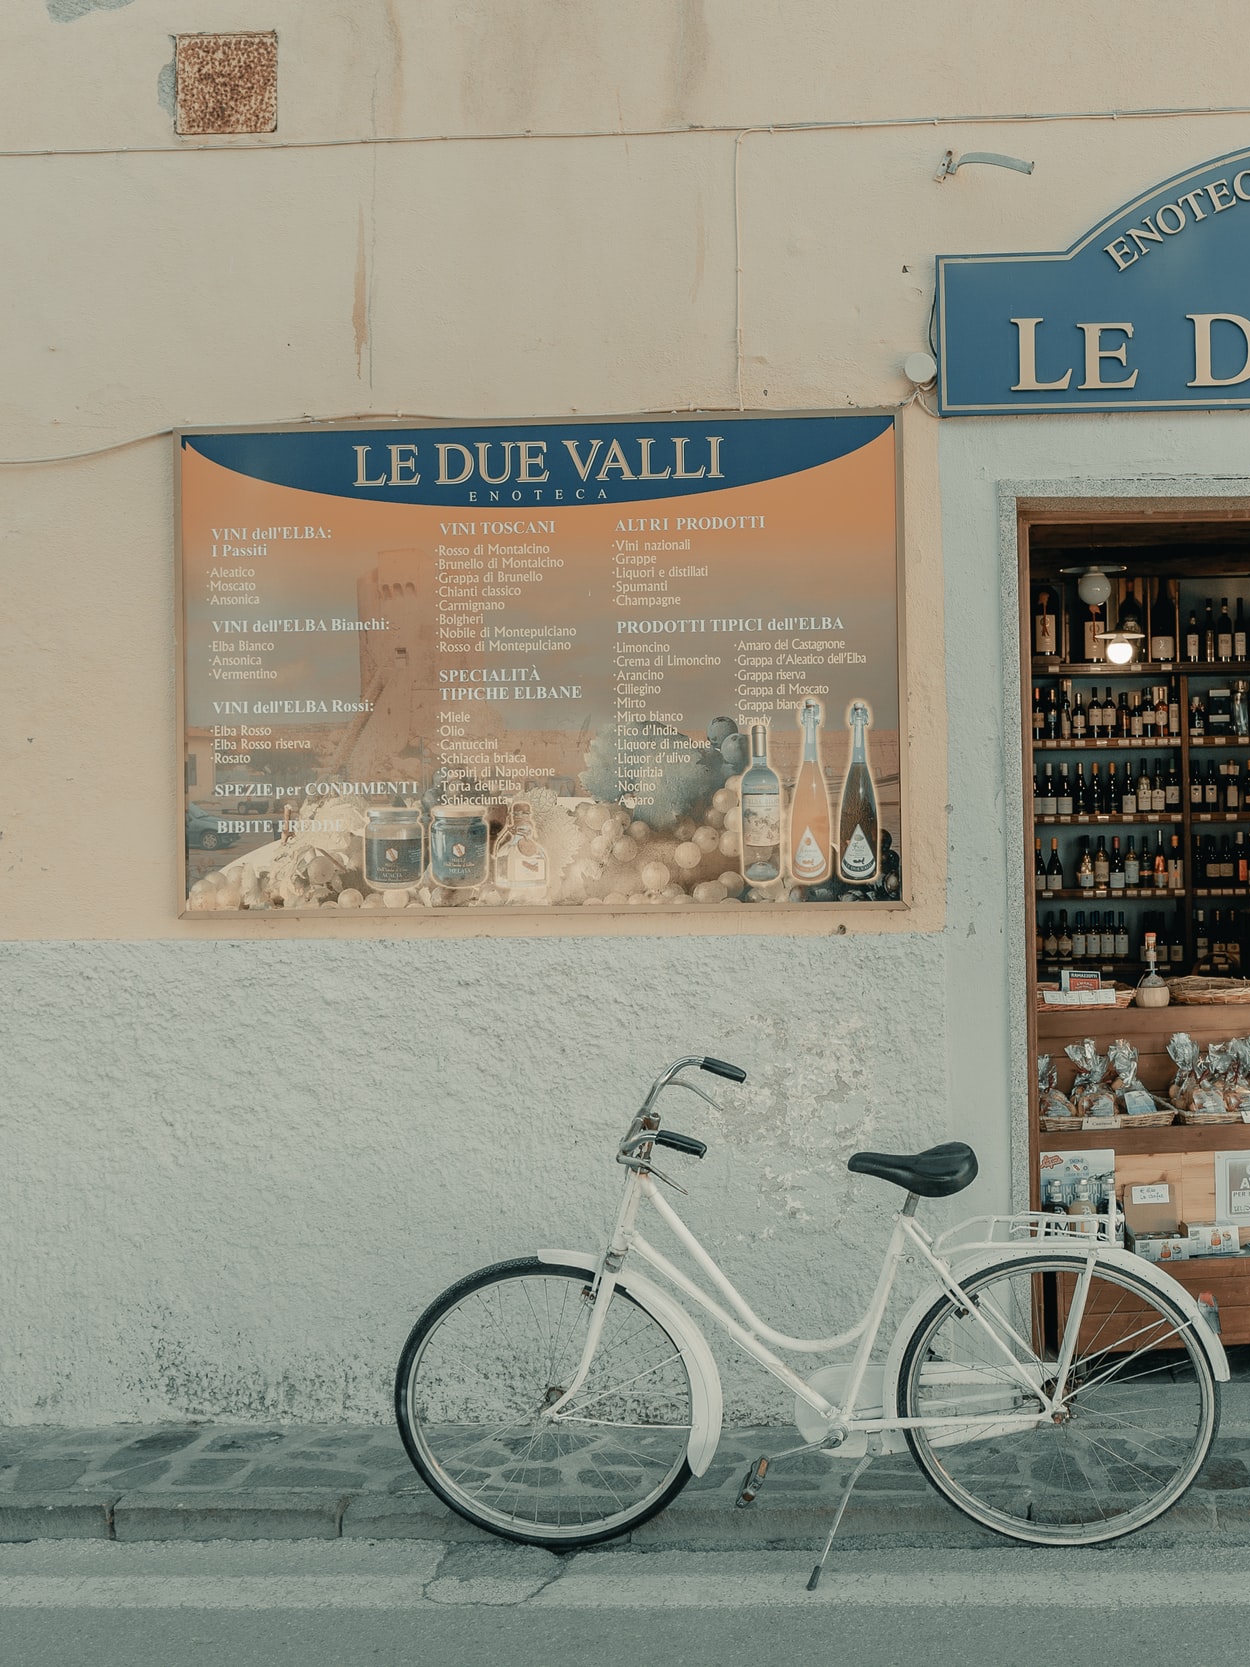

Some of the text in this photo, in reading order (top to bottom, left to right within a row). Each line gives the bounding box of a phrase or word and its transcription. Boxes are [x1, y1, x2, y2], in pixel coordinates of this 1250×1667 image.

[1010, 317, 1140, 391] LE
[352, 436, 725, 486] LE DUE VALLI
[469, 488, 607, 502] ENOTECA
[439, 521, 555, 535] VINI TOSCANI
[615, 516, 766, 532] ALTRI PRODOTTI
[212, 526, 332, 541] VINI dell'ELBA:
[212, 544, 267, 557] I Passiti
[438, 543, 550, 556] Rosso di Montalcino
[616, 539, 691, 551] Vini nazionali
[439, 557, 564, 570] Brunello di Montalcino
[616, 553, 657, 566] Grappe
[210, 566, 255, 578] Aleatico
[439, 571, 543, 585] Grappa di Brunello
[616, 566, 708, 580] Liquori e distillati
[210, 580, 256, 591] Moscato
[438, 585, 522, 597] Chianti classico
[616, 580, 668, 594] Spumanti
[210, 594, 260, 605] Ansonica
[616, 594, 681, 607] Champagne
[439, 600, 505, 613] Carmignano
[212, 618, 390, 633] VINI dell'ELBA Bianchi:
[439, 613, 484, 626] Bolgheri
[617, 617, 844, 634] PRODOTTI TIPICI dell'ELBA
[439, 624, 577, 638] Nobile di Montepulciano
[213, 640, 275, 651] Elba Bianco
[440, 638, 572, 652] Rosso di Montepulciano
[617, 641, 670, 653] Limoncino
[738, 638, 845, 651] Amaro del Castagnone
[212, 654, 262, 666] Ansonica
[617, 654, 721, 667] Crema di Limoncino
[738, 655, 772, 668] Grappa
[212, 668, 277, 680] Vermentino
[439, 665, 541, 683] SPECIALITÀ
[617, 670, 664, 681] Arancino
[738, 669, 806, 683] Grappa riserva
[440, 685, 582, 701] TIPICHE ELBANE
[617, 684, 661, 697] Ciliegino
[738, 683, 829, 697] Grappa di Moscato
[213, 699, 375, 714] VINI dell'ELBA Rossi:
[617, 697, 646, 709] Mirto
[738, 698, 806, 713] Grappa bianca
[440, 712, 470, 723] Miele
[617, 710, 683, 722] Mirto bianco
[738, 714, 771, 727] Brandy
[215, 725, 272, 736] Elba Rosso
[440, 725, 465, 737] Olio
[617, 725, 638, 736] Fico
[215, 737, 310, 750] Elba Rosso riserva
[440, 739, 498, 750] Cantuccini
[617, 738, 711, 752] Liquore di melone
[215, 753, 251, 764] Rosato
[440, 752, 526, 764] Schiaccia briaca
[618, 753, 651, 766] Liquor
[440, 766, 556, 779] Sospiri di Napoleone
[618, 767, 663, 780] Liquirizia
[215, 782, 418, 799] SPEZIE per CONDIMENTI
[441, 781, 471, 792] Torta
[618, 781, 656, 792] Nocino
[441, 794, 508, 806] Schiacciunta
[618, 795, 654, 806] Amaro
[218, 820, 273, 833] BIBITE
